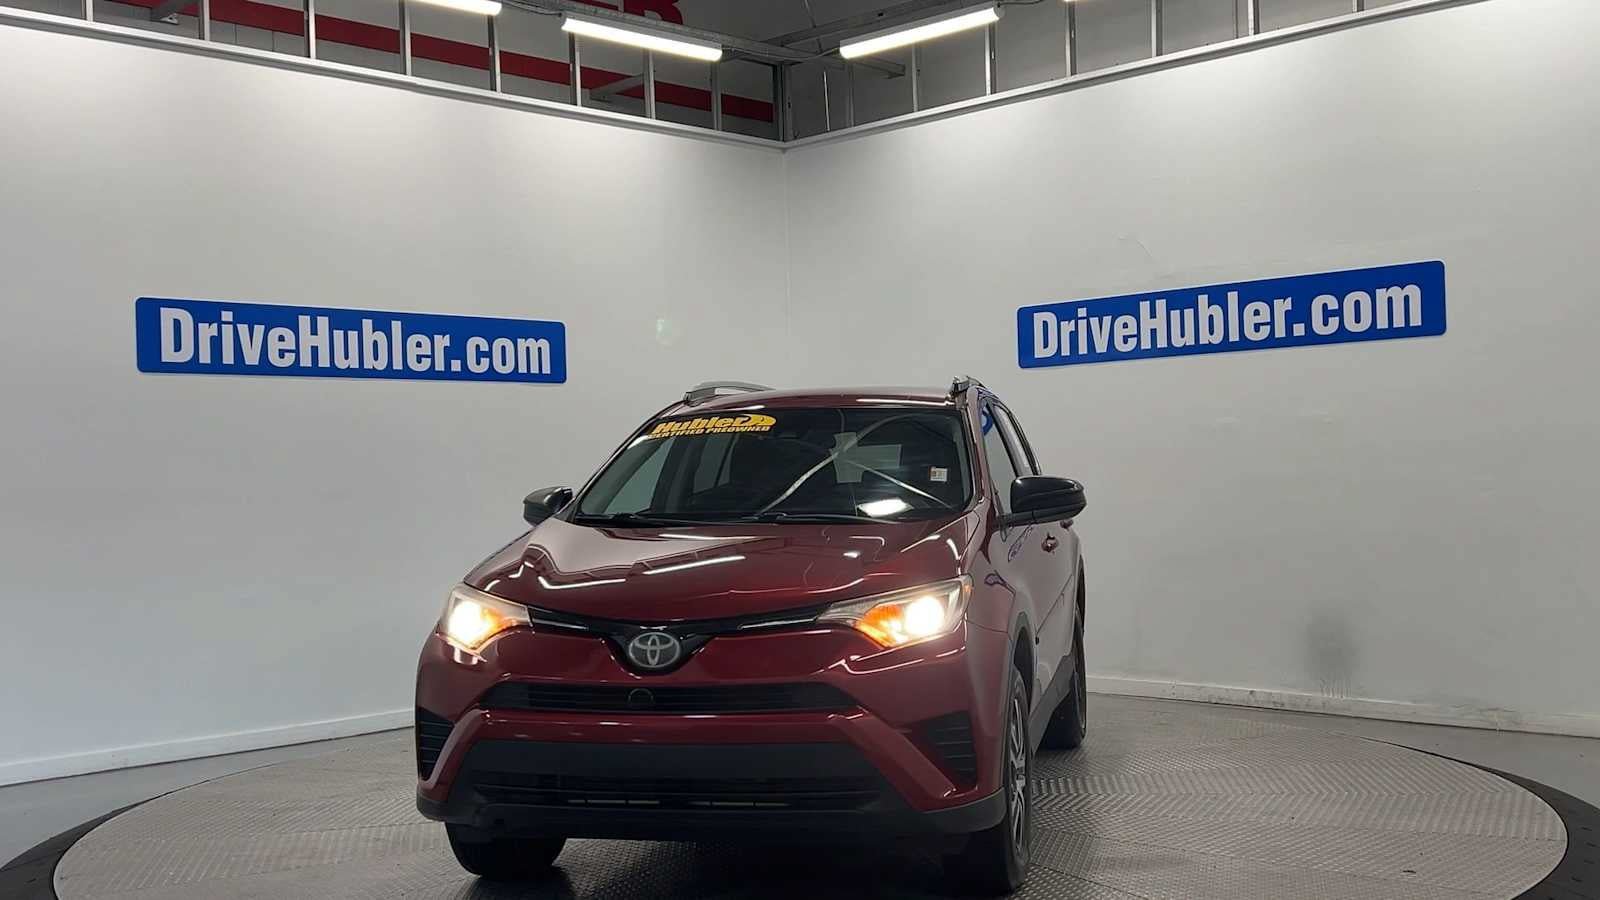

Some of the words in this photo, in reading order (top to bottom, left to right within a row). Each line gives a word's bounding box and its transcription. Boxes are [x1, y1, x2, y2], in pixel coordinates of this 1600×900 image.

[161, 308, 551, 375] DriveHubler.com
[1033, 284, 1421, 359] DriveHubler.com
[651, 415, 753, 434] Hubler
